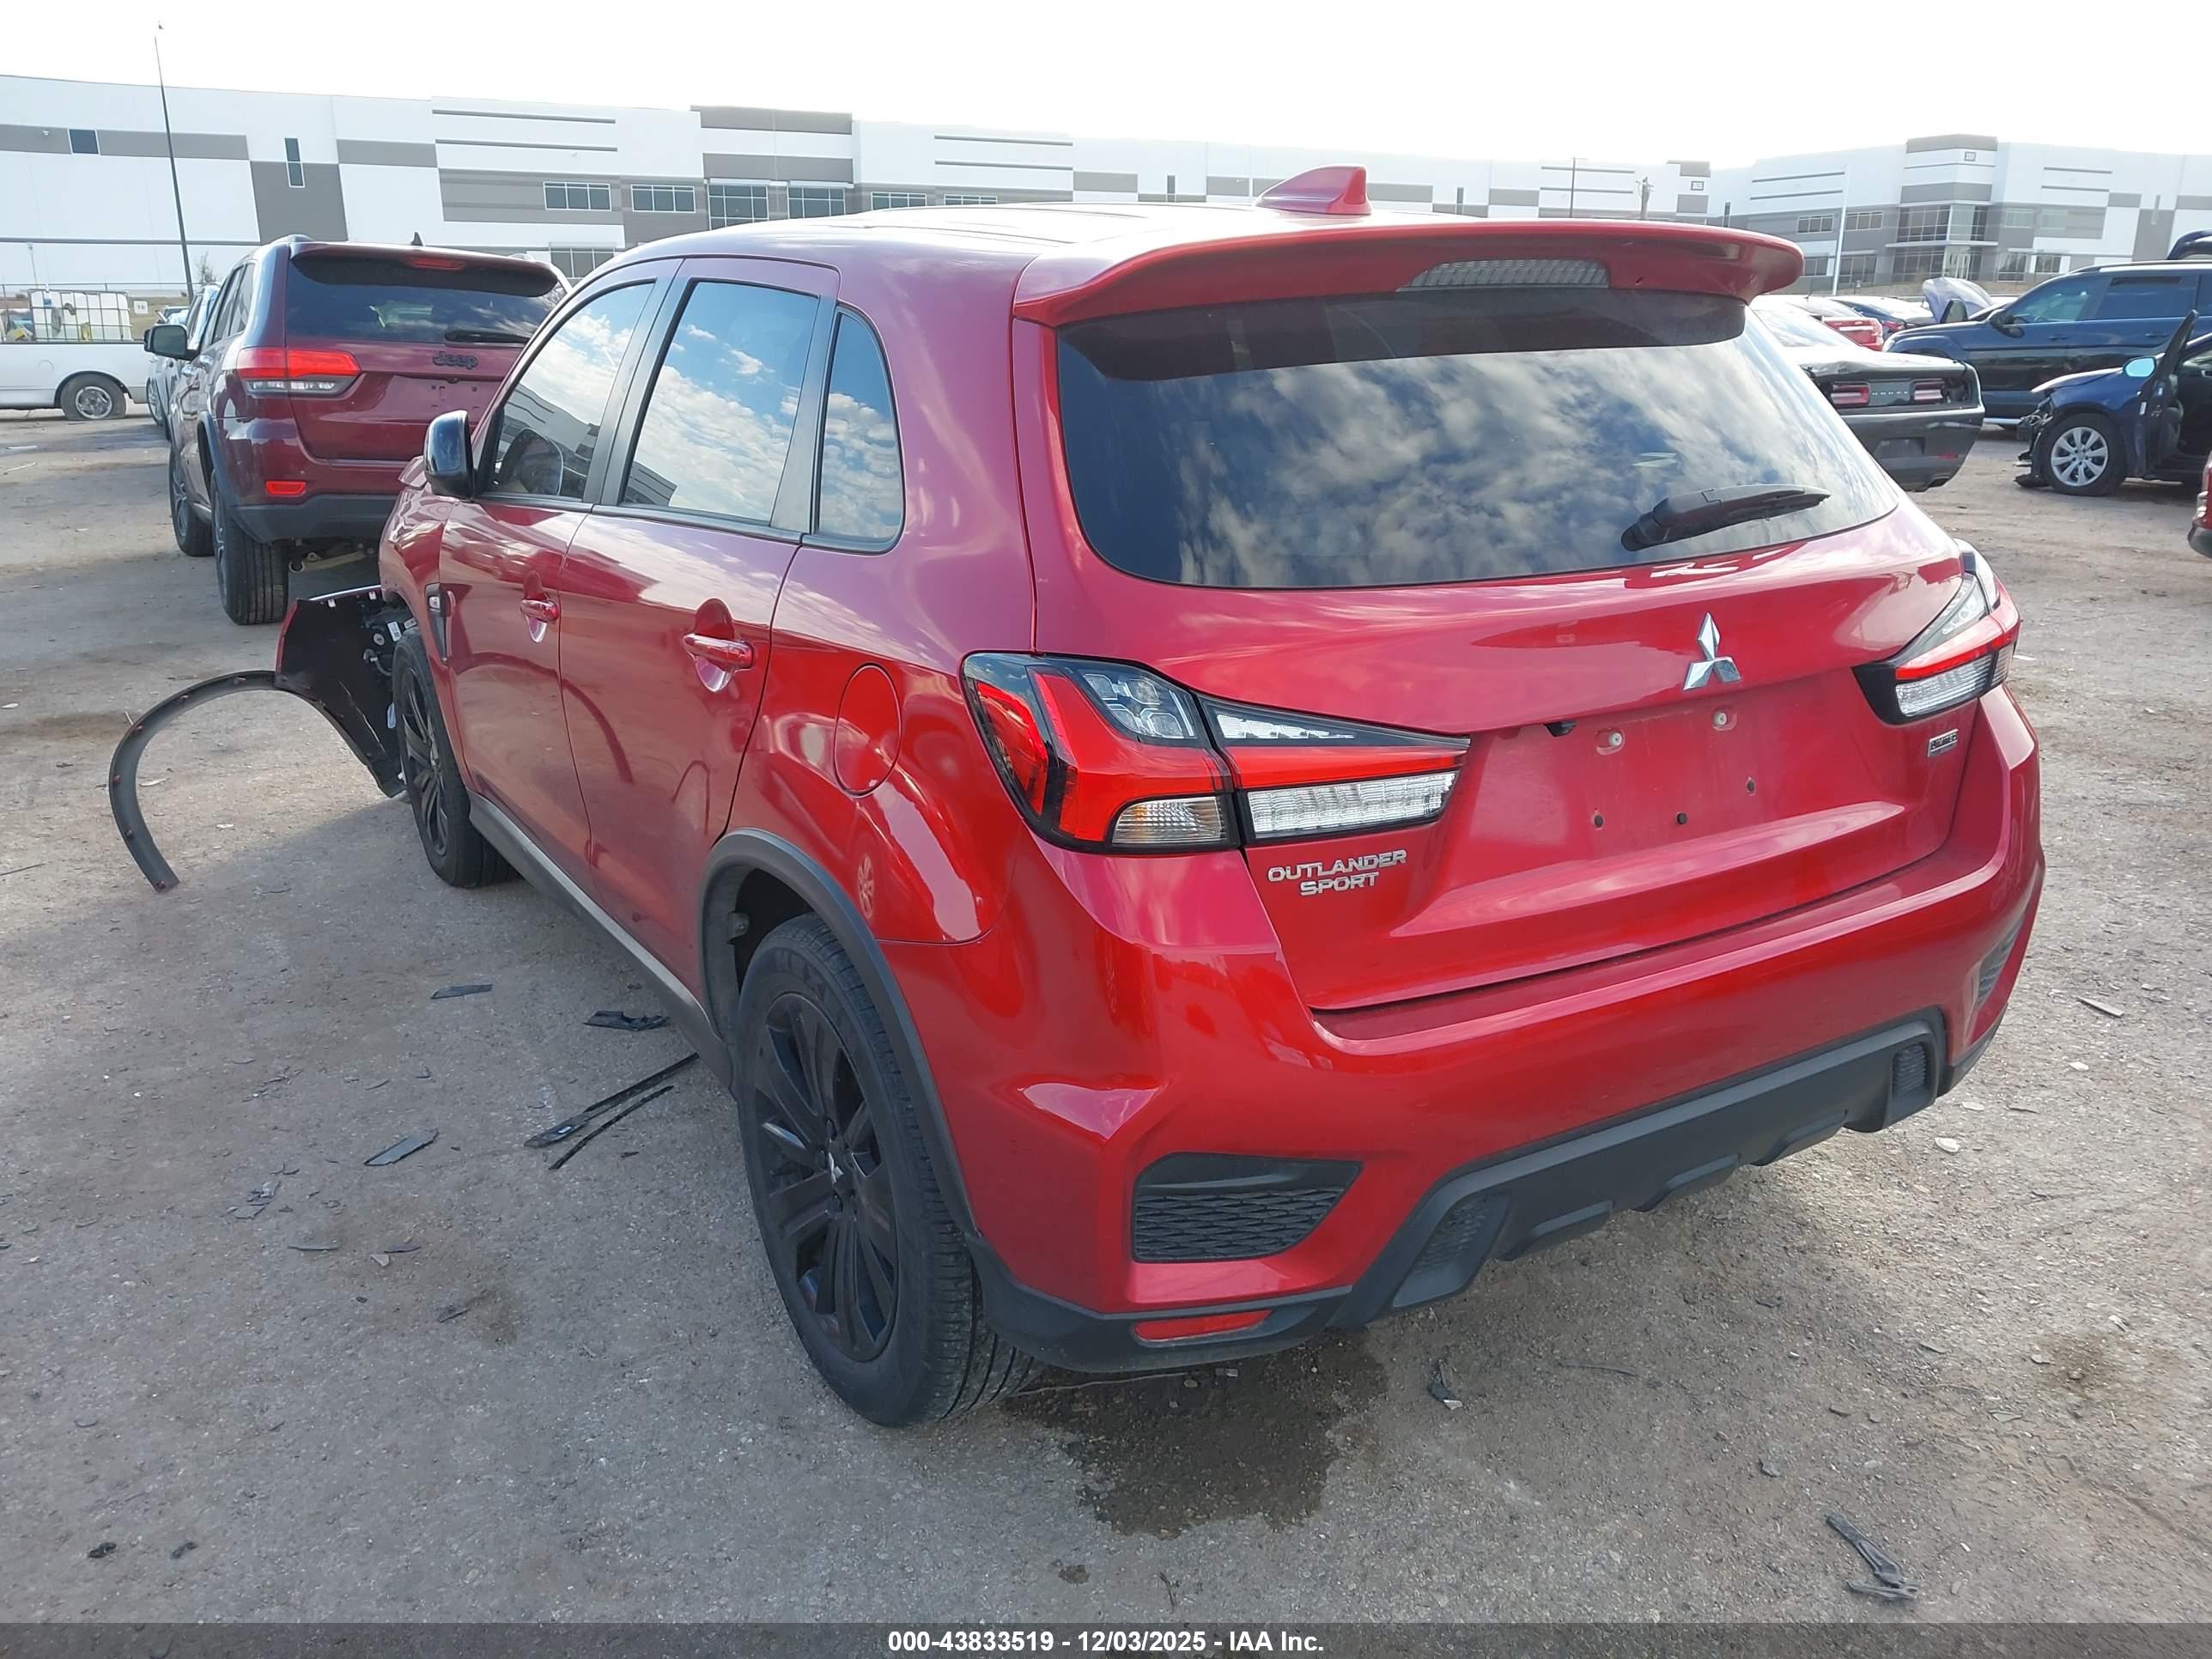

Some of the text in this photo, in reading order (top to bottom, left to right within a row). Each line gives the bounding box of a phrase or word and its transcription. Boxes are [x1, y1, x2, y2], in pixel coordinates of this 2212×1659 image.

[433, 351, 478, 369] Jeep
[1267, 849, 1407, 882] OUTLANDER
[1299, 872, 1380, 896] SPORT
